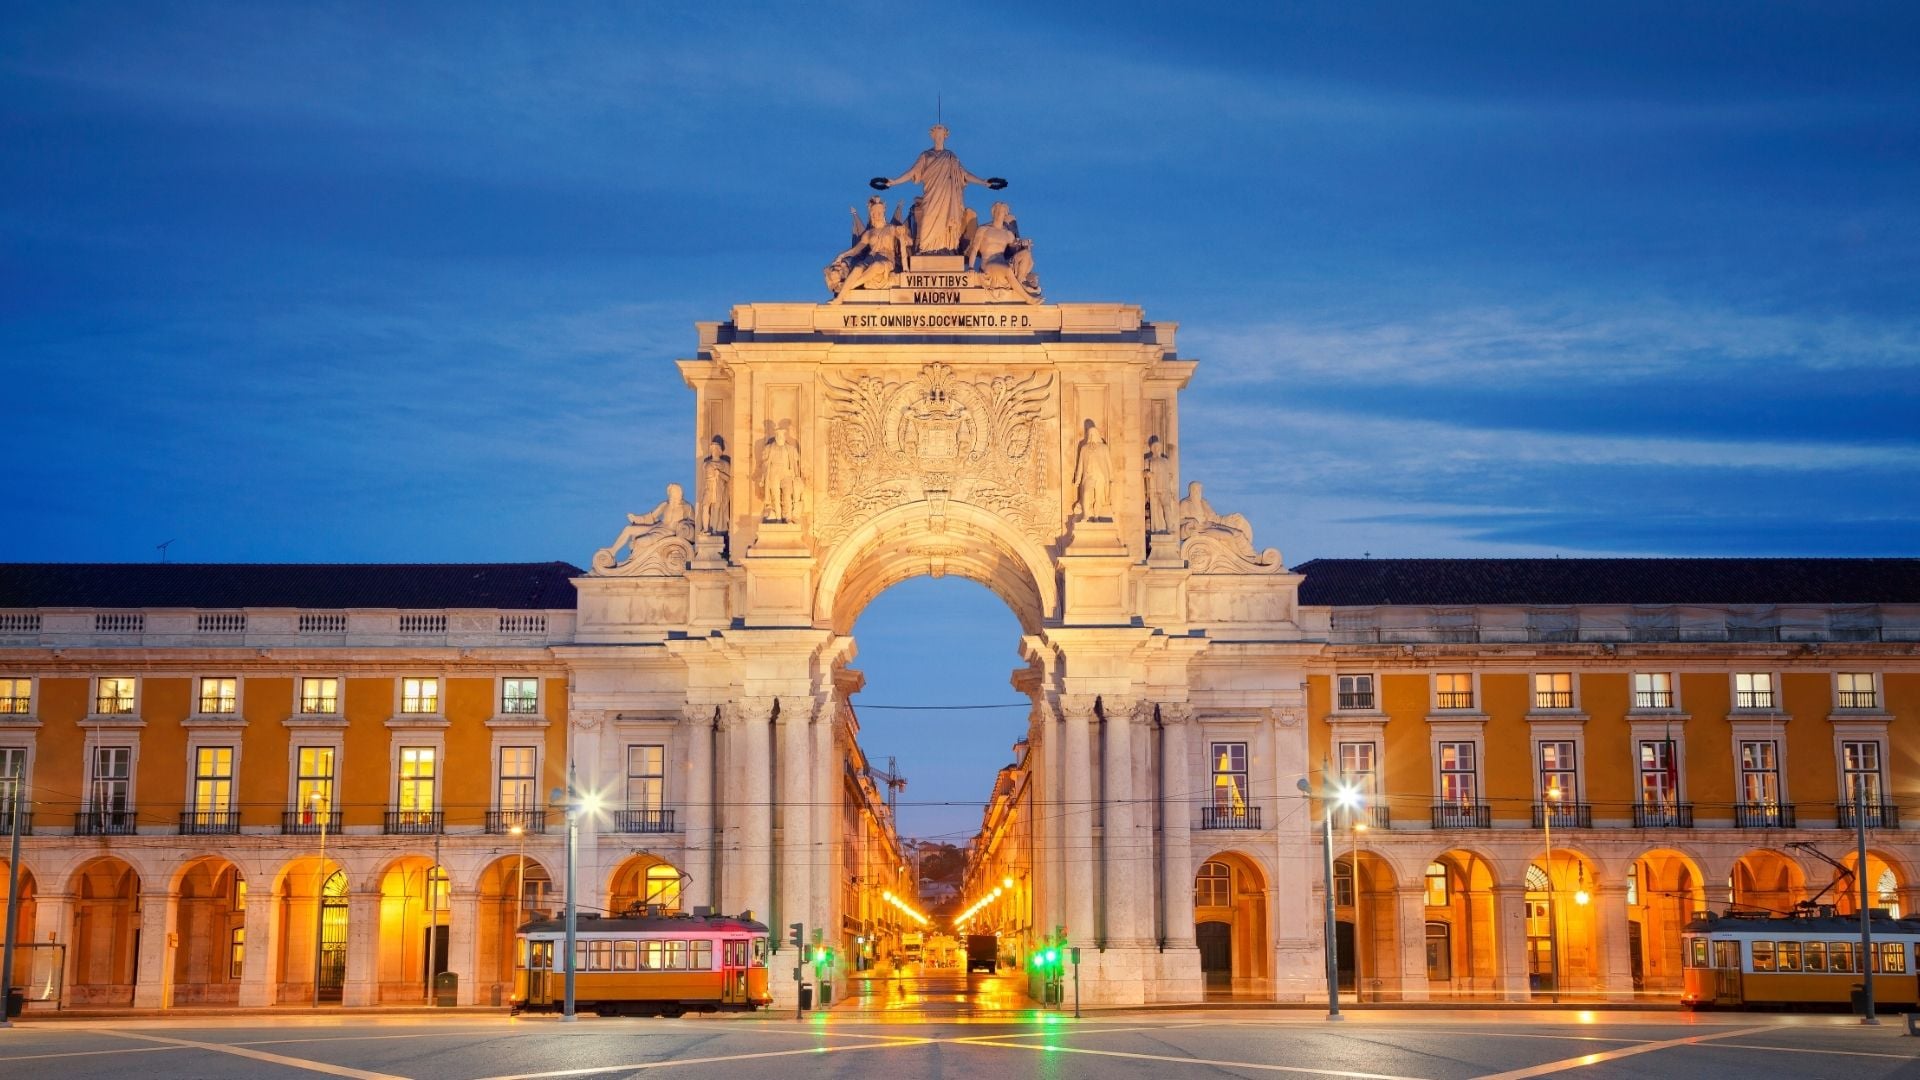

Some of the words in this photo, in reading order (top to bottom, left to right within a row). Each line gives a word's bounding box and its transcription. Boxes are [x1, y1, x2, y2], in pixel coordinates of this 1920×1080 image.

[906, 275, 969, 287] VIRTVTIBVS
[913, 292, 961, 304] MAIORVM
[860, 315, 878, 327] SIT.
